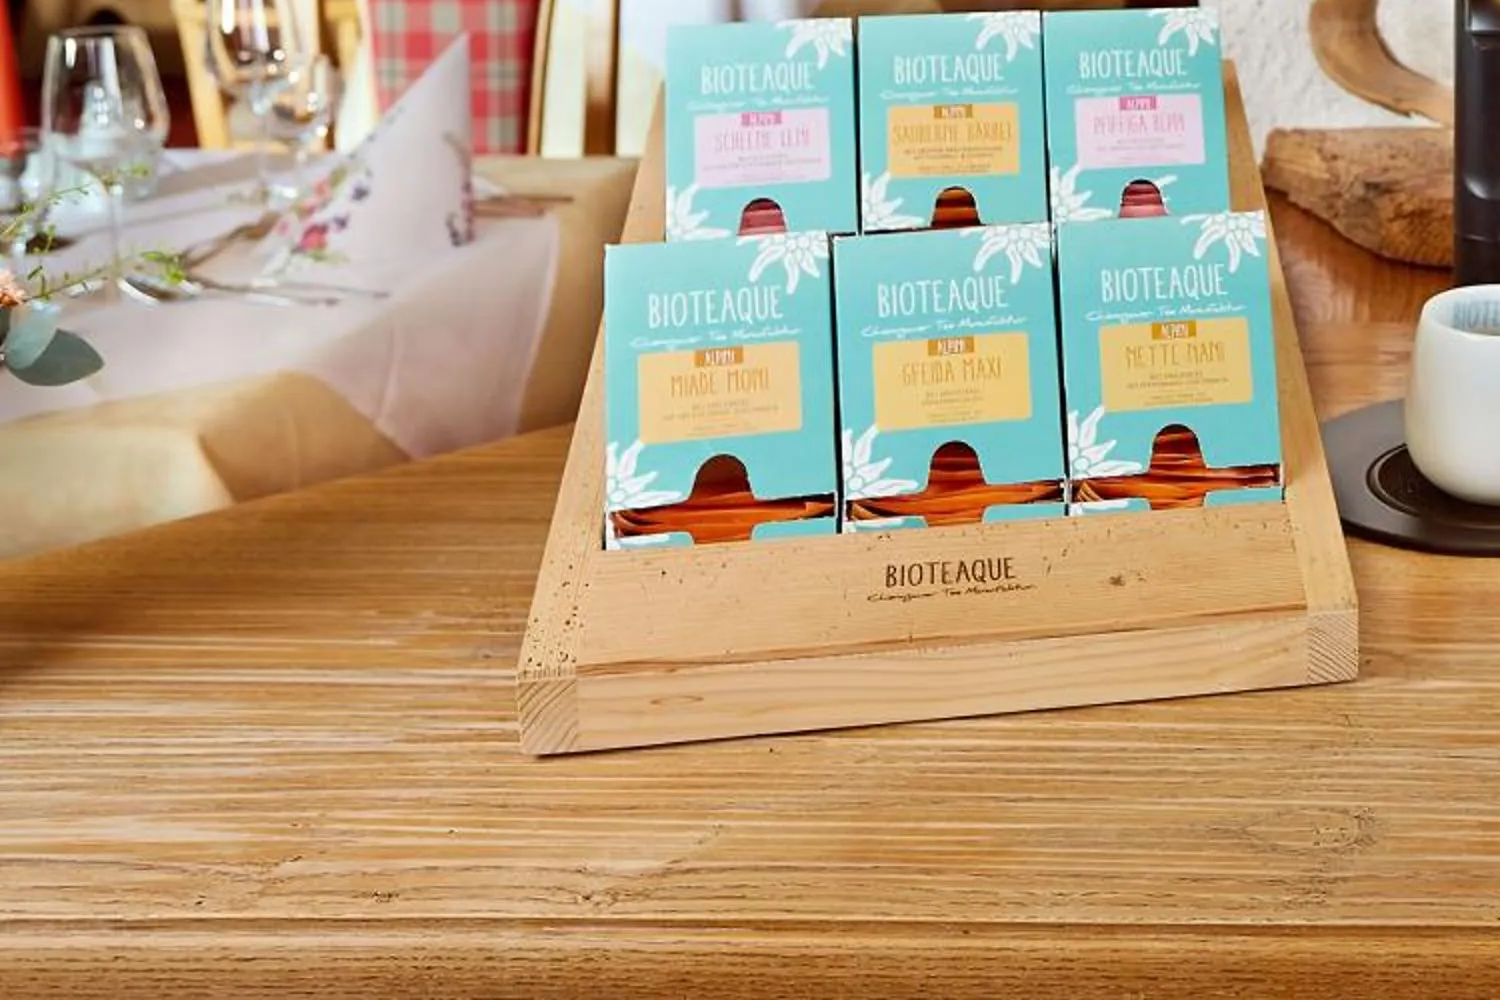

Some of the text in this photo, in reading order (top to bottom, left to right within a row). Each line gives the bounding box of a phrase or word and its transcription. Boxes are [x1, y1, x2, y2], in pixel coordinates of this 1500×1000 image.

[701, 62, 815, 94] BIOTEAQUE
[894, 53, 1004, 84] BIOTEAQUE
[1079, 48, 1187, 79] BIOTEAQUE
[878, 275, 1009, 318] BIOTEAQUE
[1101, 263, 1228, 303] BIOTEAQUE
[648, 285, 784, 328] BIOTEAQUE
[963, 357, 1001, 381] MAXI
[885, 557, 1016, 588] BIOTEAQUE
